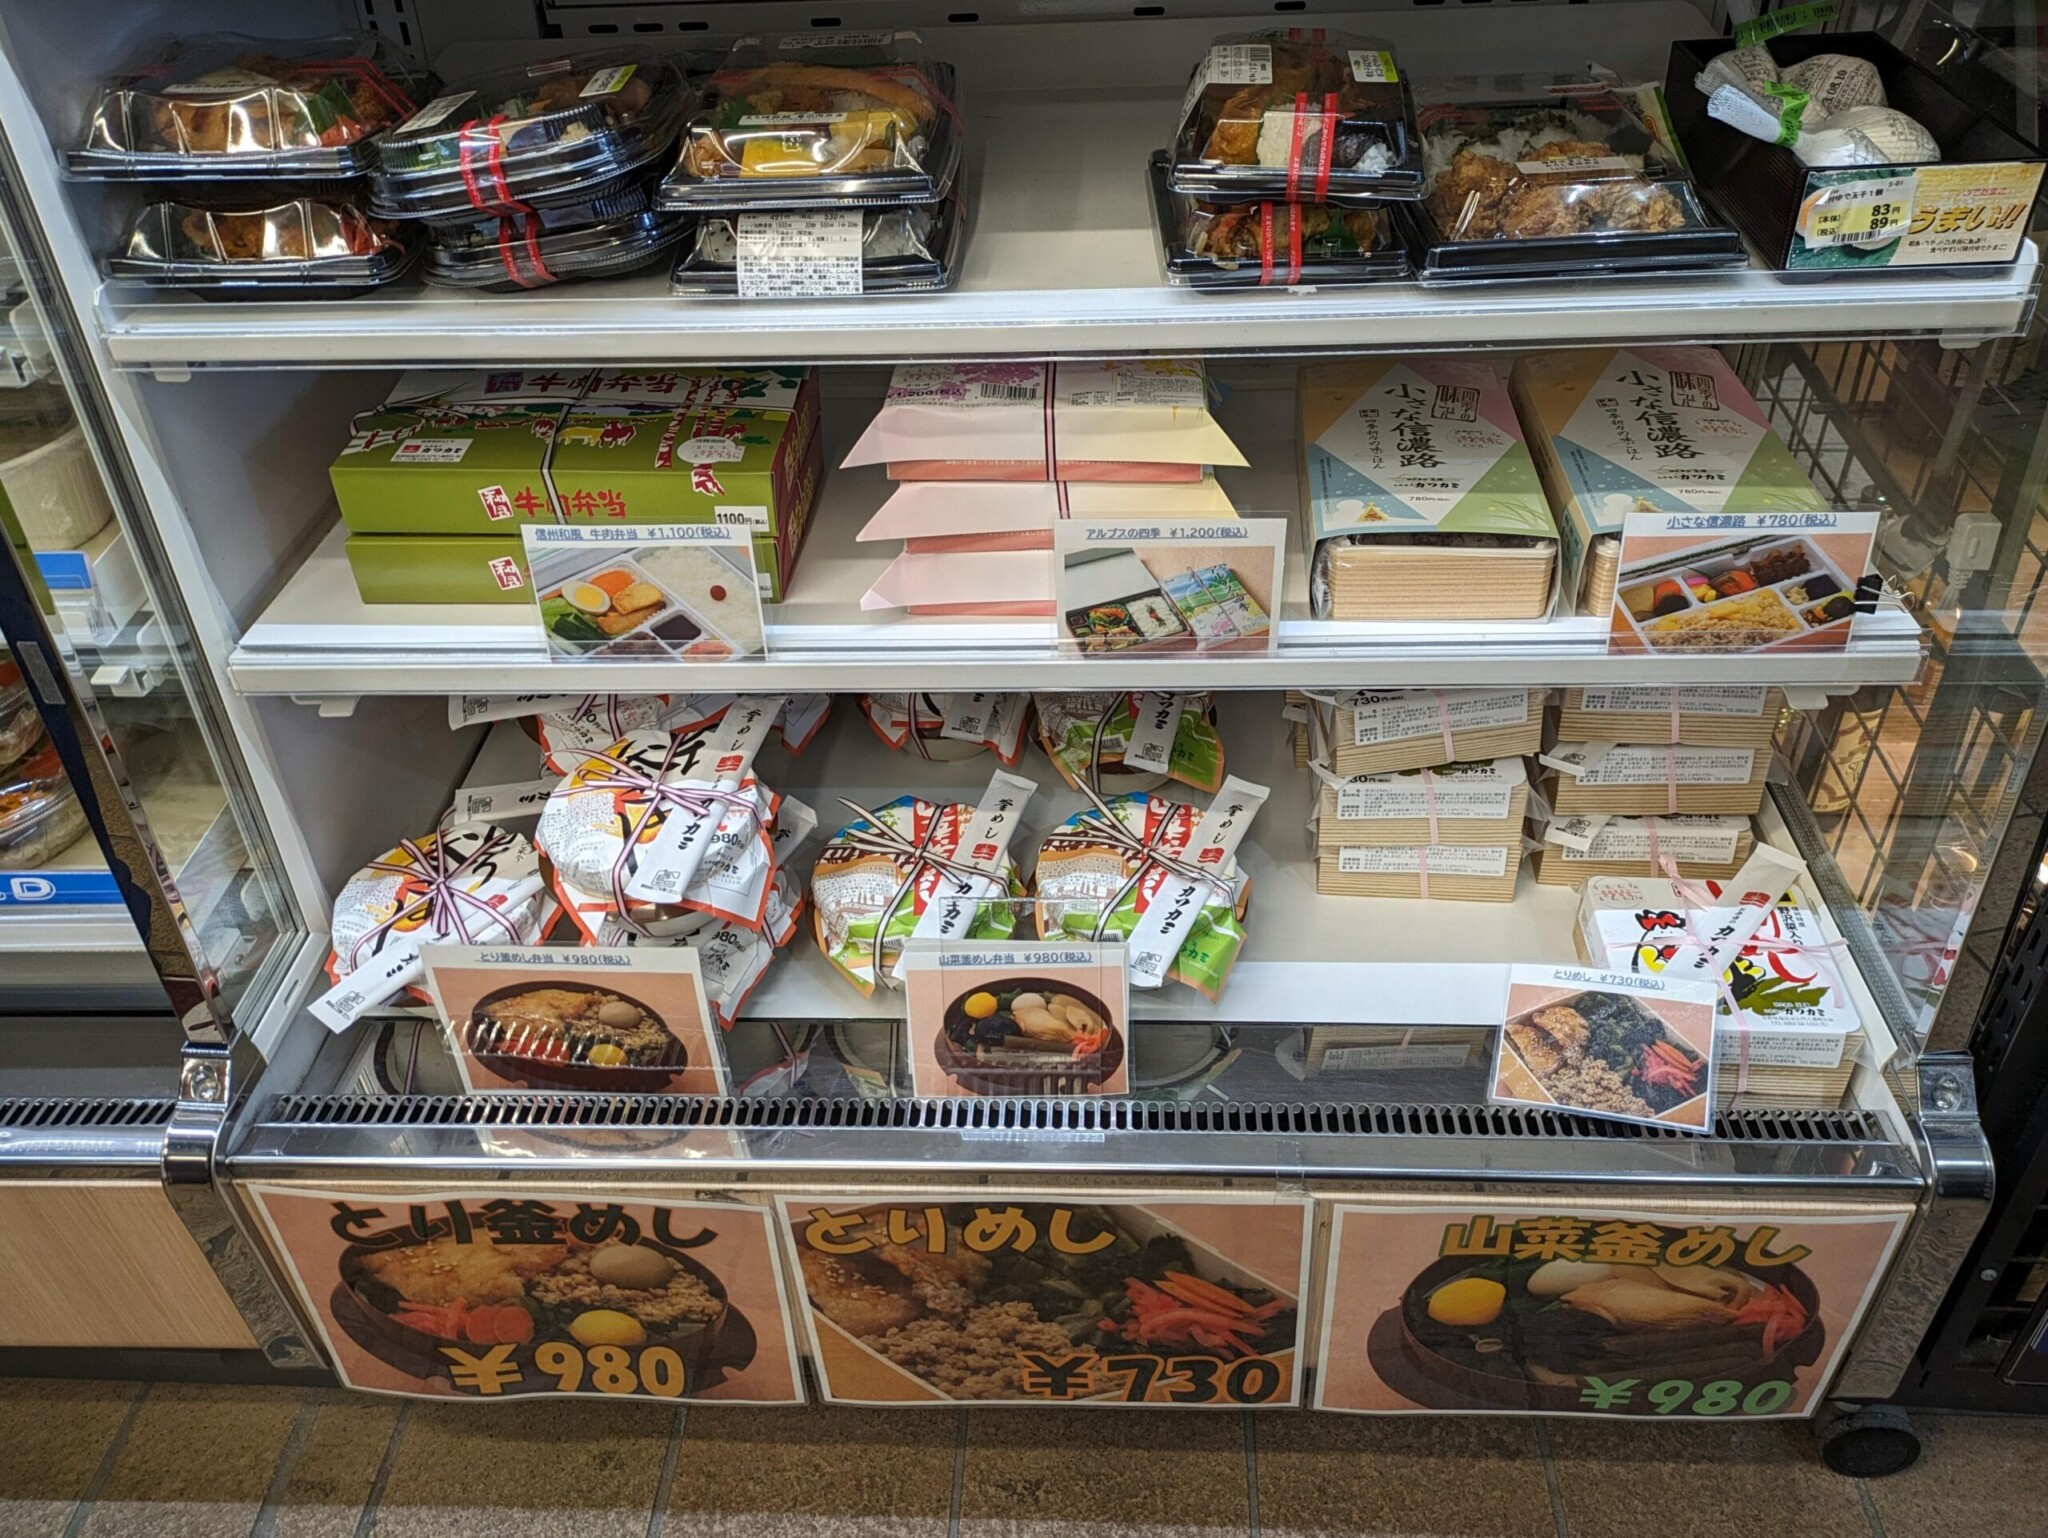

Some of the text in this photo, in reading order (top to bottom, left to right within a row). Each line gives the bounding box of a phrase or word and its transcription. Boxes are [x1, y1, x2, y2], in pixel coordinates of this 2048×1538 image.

[527, 371, 677, 394] 牛肉弁当
[1384, 383, 1447, 469] 小さな信濃路
[1616, 370, 1705, 459] 小さな信濃路
[534, 527, 582, 541] 信州和風
[590, 527, 638, 540] 牛肉弁当
[1085, 527, 1161, 539] アルプスの四季
[1667, 514, 1837, 528] 小さな信濃路 ¥780(税込)
[731, 708, 762, 751] 釜めし
[985, 798, 1014, 840] 釜めし
[1213, 803, 1244, 845] 釜めし
[479, 951, 631, 965] とり釜めし弁当 ¥980(税込)
[939, 951, 1093, 966] 山菜釜めし弁当 ¥980(税込)
[1553, 969, 1666, 990] とりめし ¥730(税込)
[331, 1199, 719, 1248] とり釜めし
[805, 1206, 1117, 1255] とりめし
[1439, 1215, 1812, 1267] 山菜釜めし
[438, 1340, 686, 1398] ¥980
[1016, 1350, 1285, 1403] ¥730
[1579, 1376, 1793, 1416] ¥980
